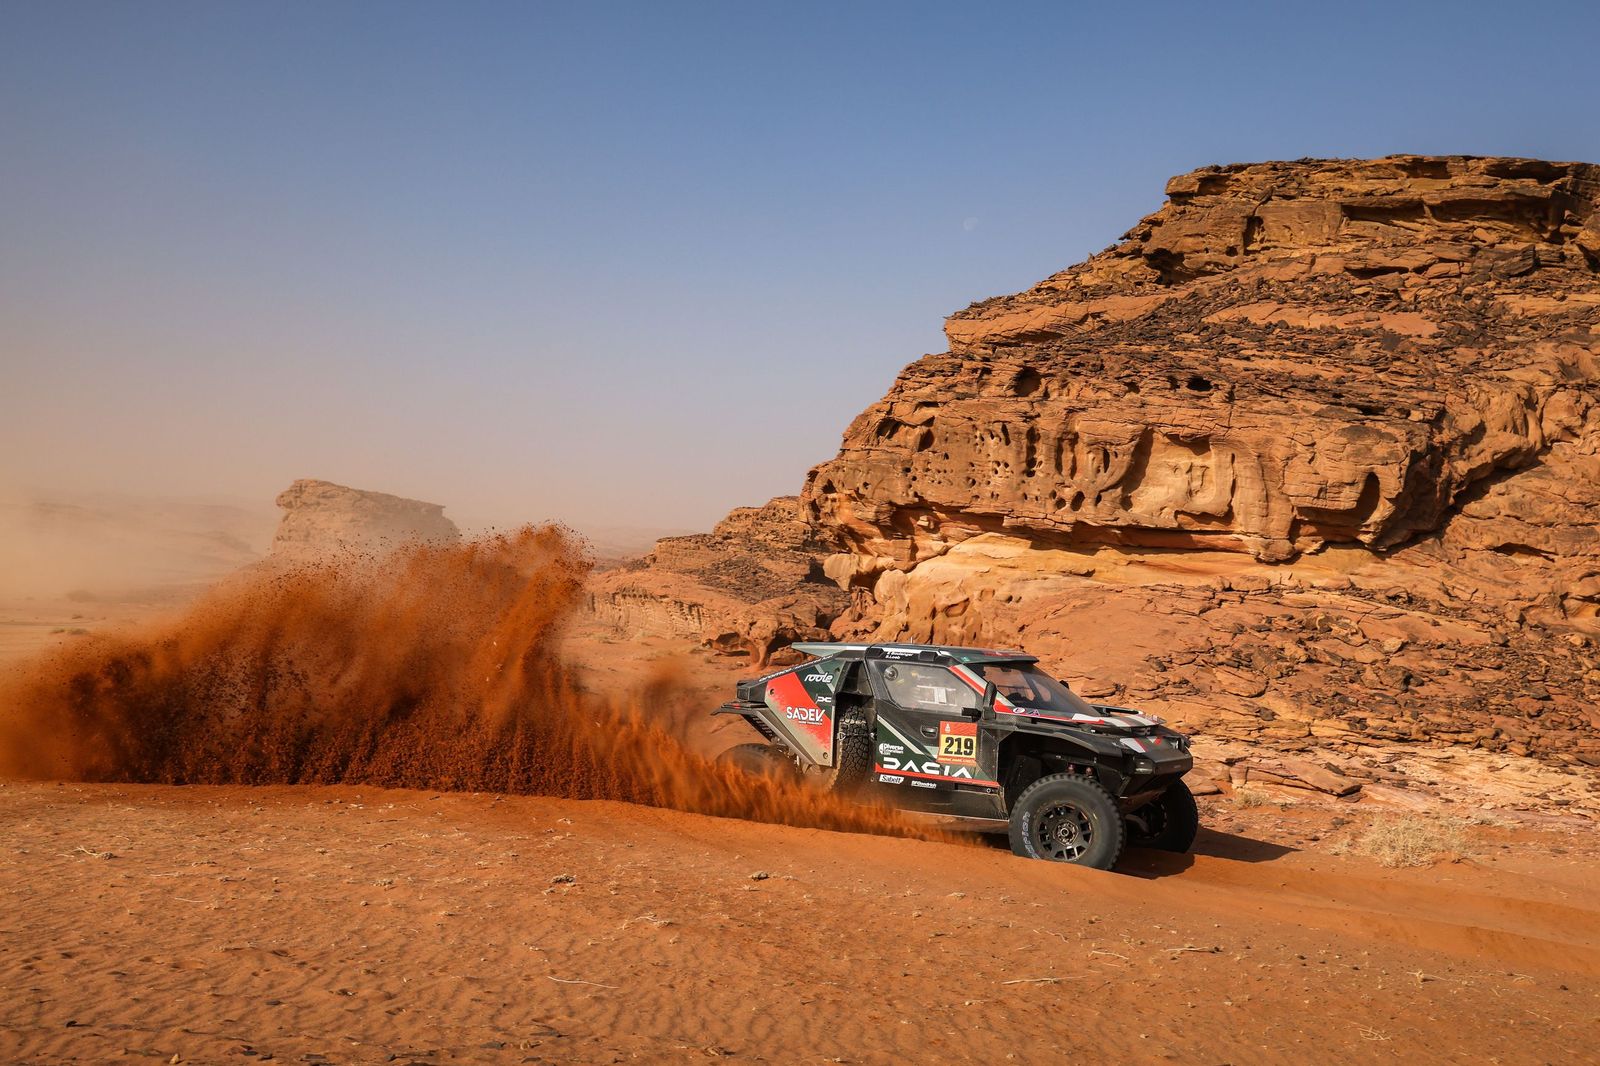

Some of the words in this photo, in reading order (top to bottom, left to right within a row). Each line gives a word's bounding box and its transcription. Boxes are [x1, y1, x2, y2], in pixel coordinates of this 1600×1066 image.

[786, 706, 826, 721] SADEV
[944, 736, 974, 756] 219
[883, 756, 973, 779] DACIA
